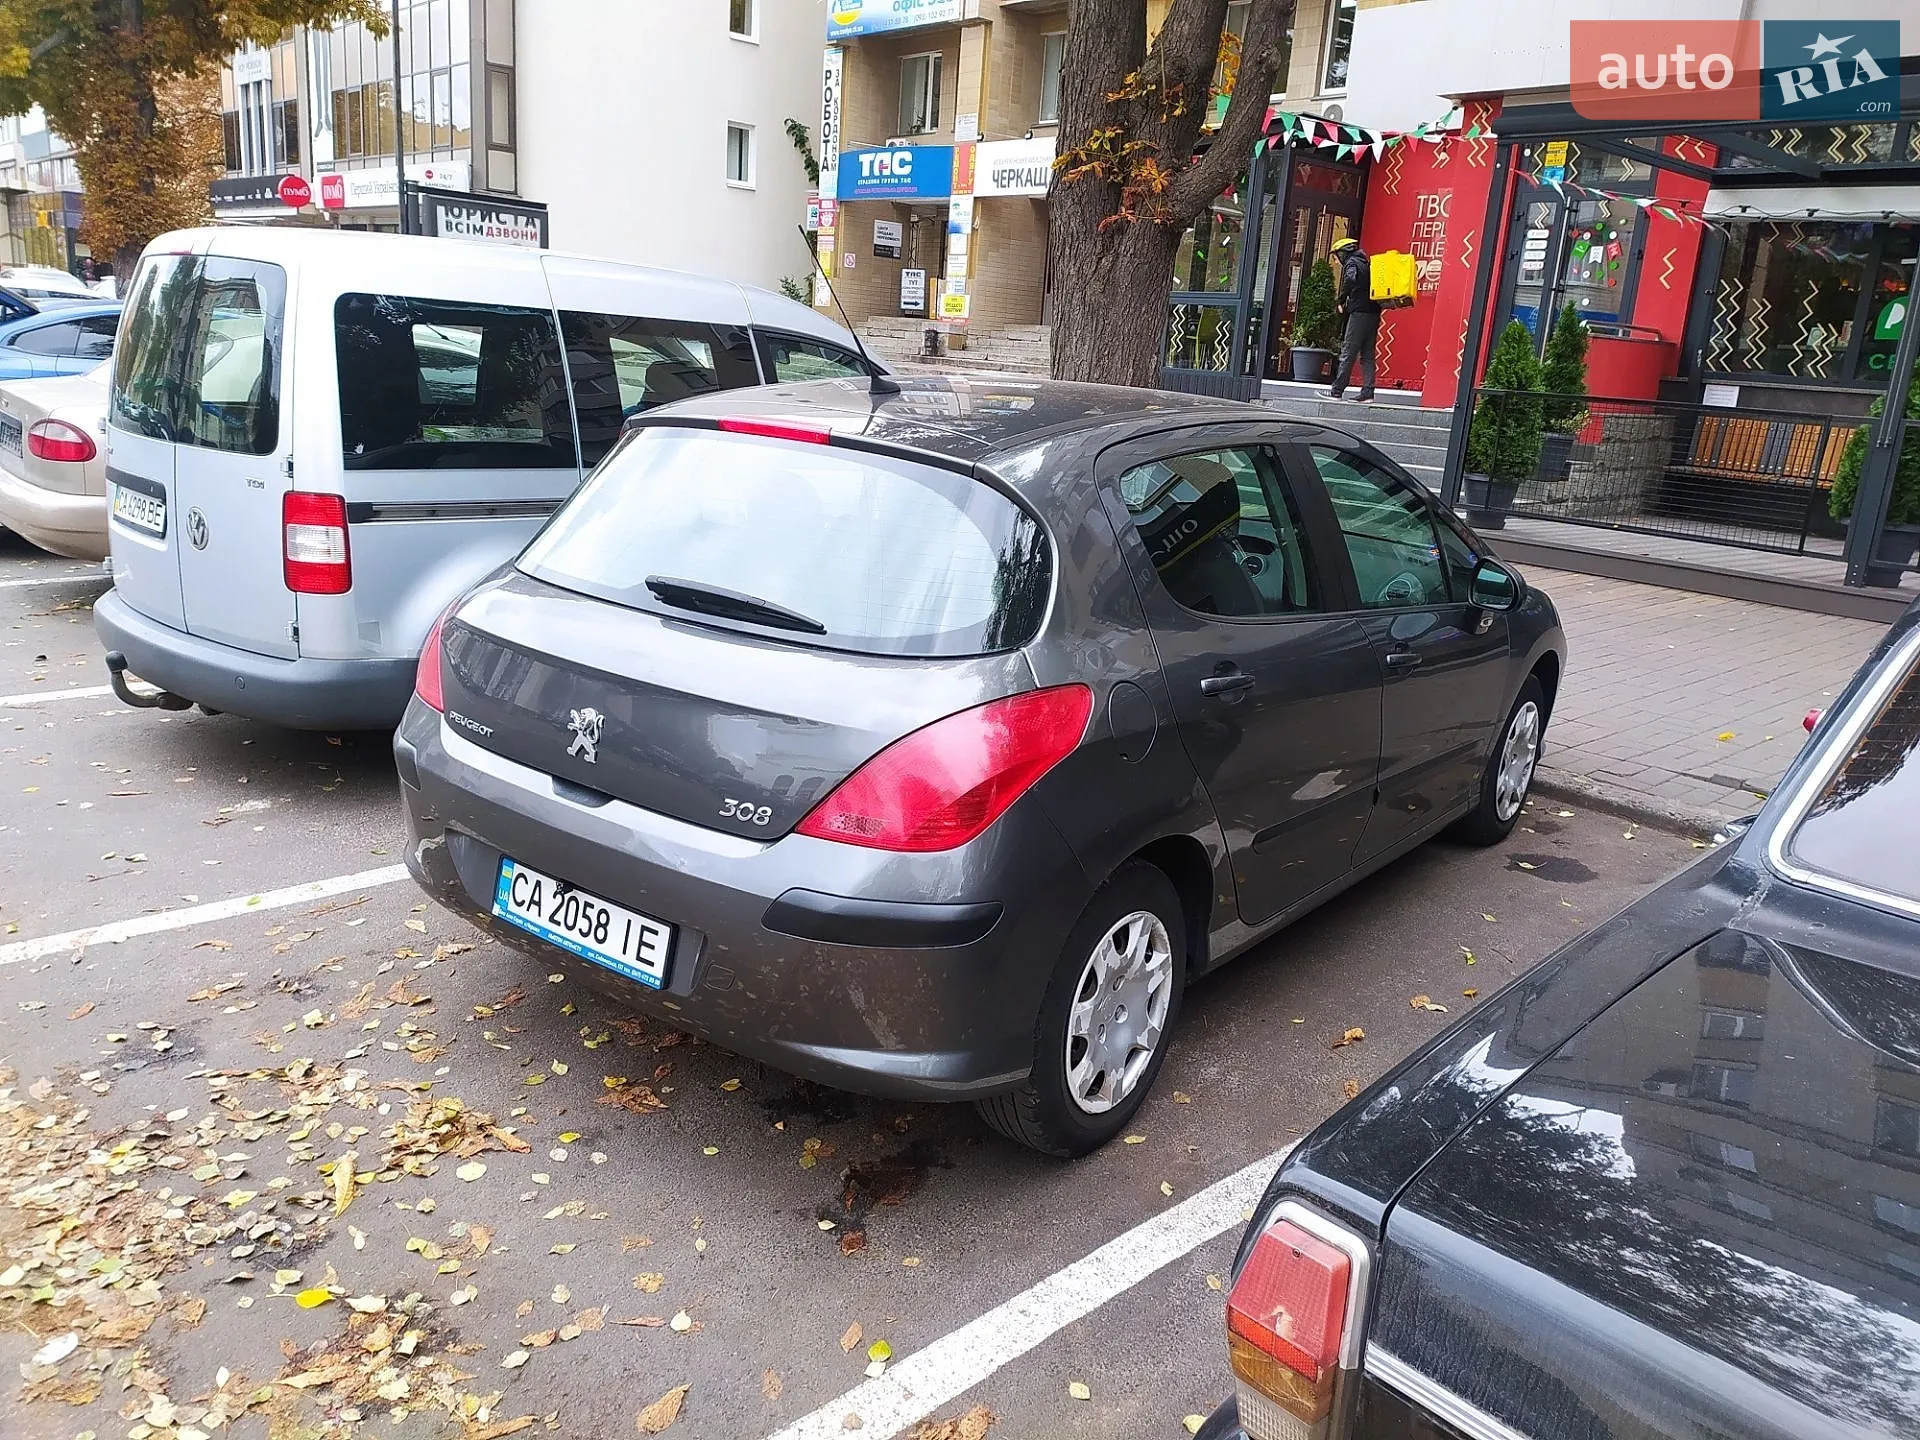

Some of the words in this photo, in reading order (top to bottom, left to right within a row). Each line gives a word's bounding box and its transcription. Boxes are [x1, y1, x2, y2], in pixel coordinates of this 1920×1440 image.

[834, 69, 840, 87] ЗА
[821, 69, 833, 172] РОБОТА
[831, 98, 839, 171] КОРДОНОМ
[858, 151, 913, 177] ТАС
[450, 710, 493, 738] PEUGEOT
[719, 798, 772, 826] 308
[499, 888, 508, 901] UA
[512, 872, 541, 918] CA
[549, 884, 610, 945] 2058
[622, 918, 659, 967] IE
